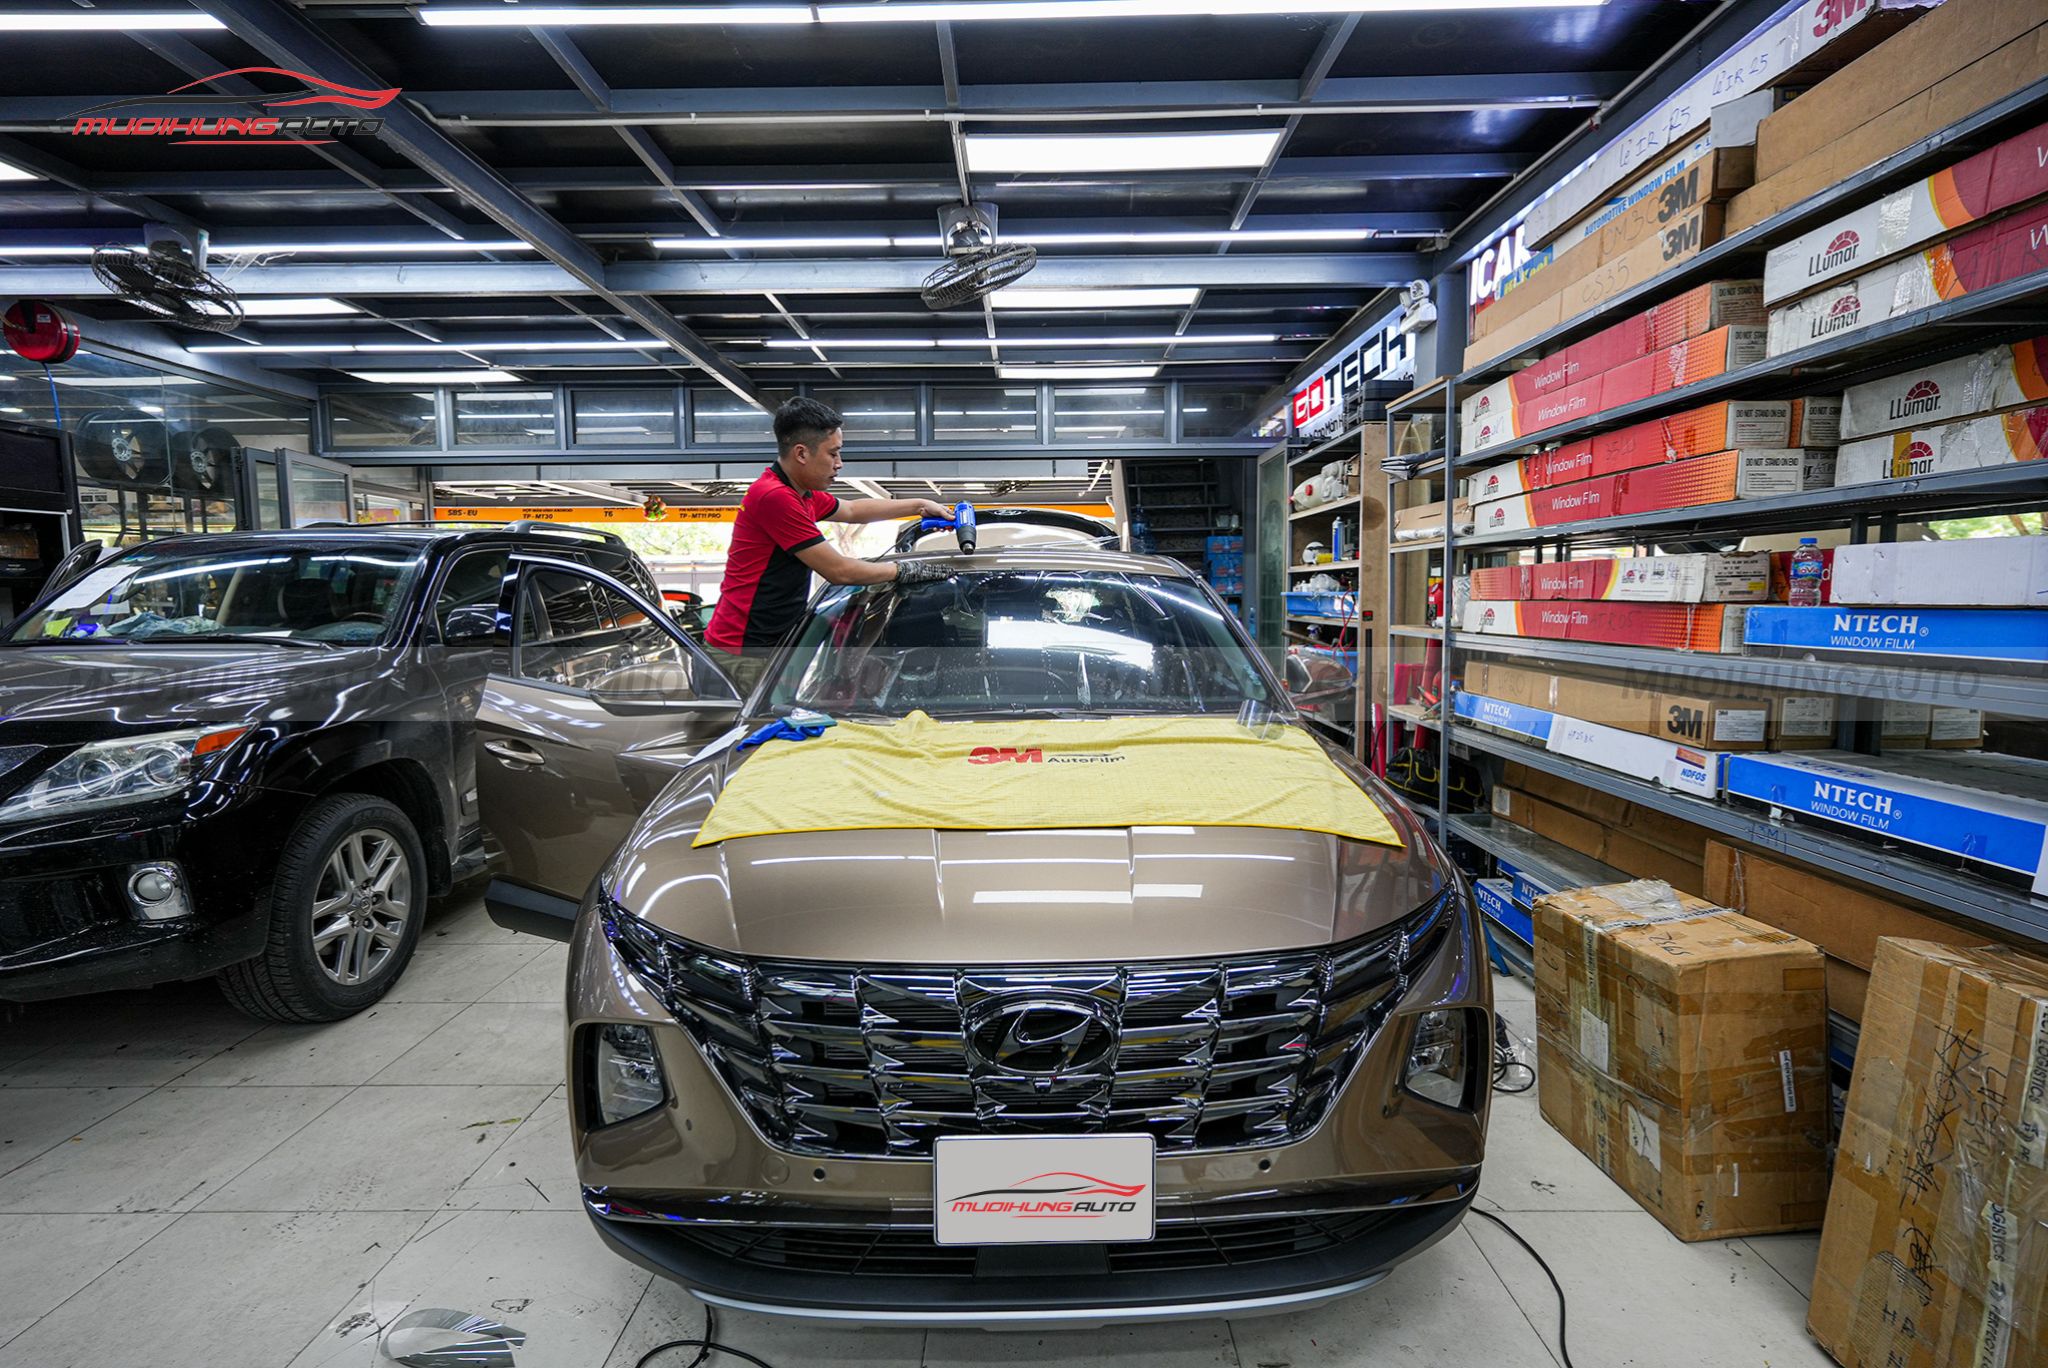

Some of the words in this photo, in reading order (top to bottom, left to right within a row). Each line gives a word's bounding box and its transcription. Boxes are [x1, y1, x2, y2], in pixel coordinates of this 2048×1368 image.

[1584, 202, 1627, 237] AUTOMOTIVE
[1627, 173, 1663, 206] WINDOW
[1664, 159, 1686, 181] FILM
[1657, 166, 1698, 224] 3M
[1663, 214, 1699, 261] 3M
[1534, 368, 1564, 389] Window
[1563, 361, 1580, 378] Film
[1538, 401, 1568, 422] Window
[1568, 395, 1586, 412] Film
[1889, 394, 1942, 421] LLumar
[1546, 457, 1575, 475] Window
[1576, 453, 1592, 468] Film
[1552, 494, 1581, 510] Window
[1582, 492, 1599, 506] Film
[1541, 576, 1567, 590] Window
[1568, 575, 1584, 589] Film
[1542, 609, 1570, 624] Window
[1570, 610, 1588, 624] Film
[1833, 614, 1919, 634] NTECH
[1830, 635, 1883, 648] WINDOW
[1884, 637, 1916, 649] FILM
[1484, 702, 1510, 718] NTECH
[1667, 704, 1705, 738] 3M
[967, 746, 1043, 765] 3M
[1047, 754, 1126, 764] AutoFilm
[1680, 767, 1706, 781] NDFOS
[1814, 780, 1893, 816] NTECH
[1811, 800, 1859, 823] WINDOW
[1860, 812, 1890, 831] FILM
[1478, 888, 1502, 911] NTECH
